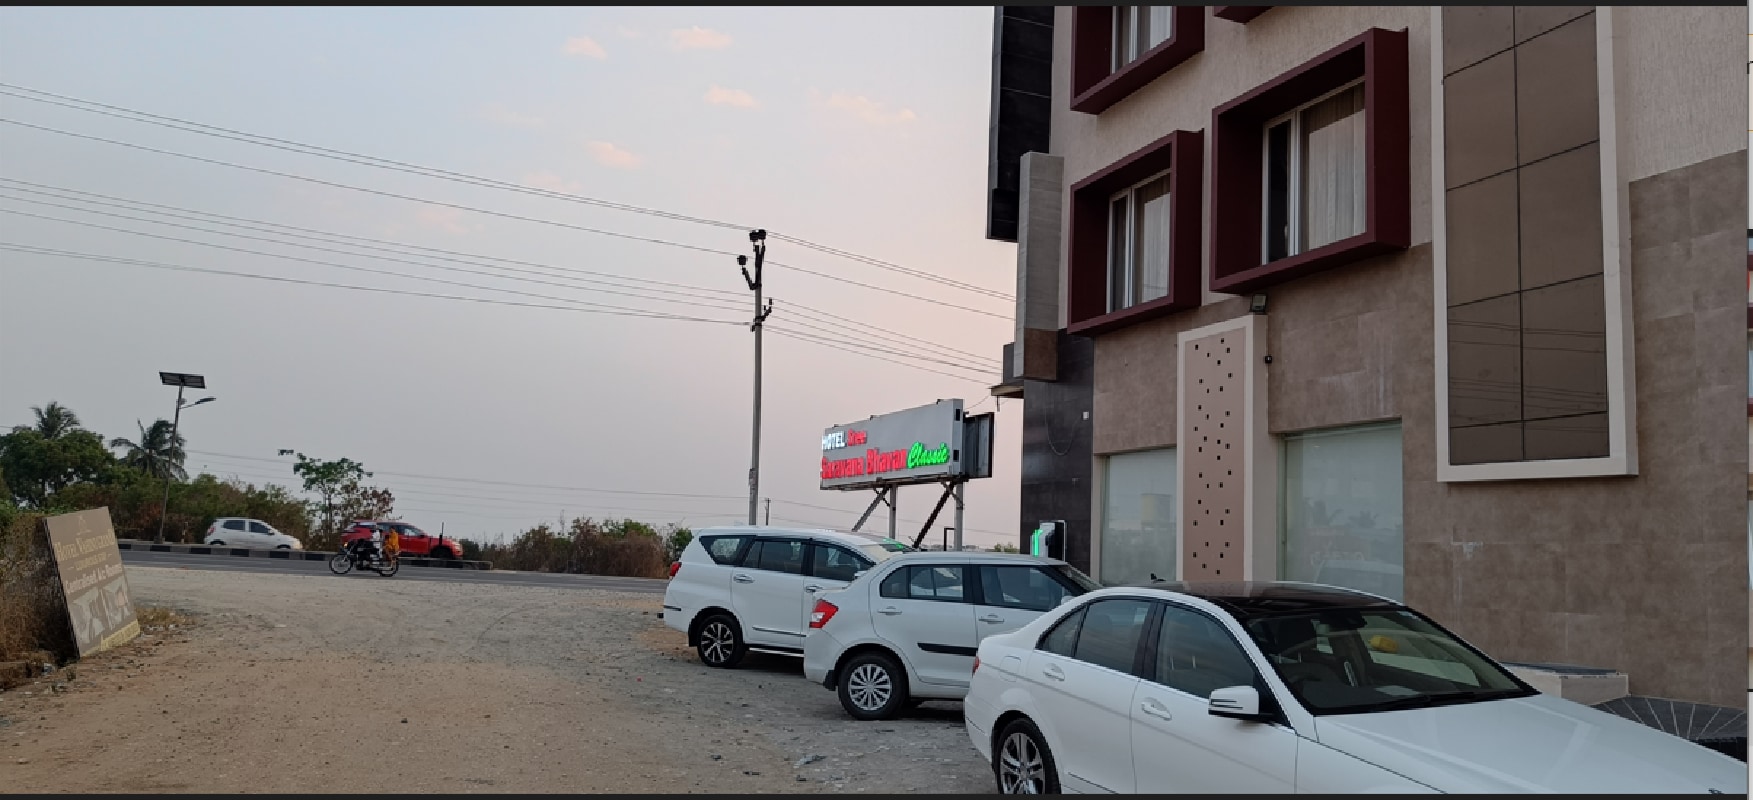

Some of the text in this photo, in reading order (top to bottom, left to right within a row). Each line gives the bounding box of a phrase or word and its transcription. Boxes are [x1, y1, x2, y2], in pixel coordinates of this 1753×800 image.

[822, 431, 845, 450] HOTEL
[821, 441, 950, 479] Saravana Bhavan Classic
